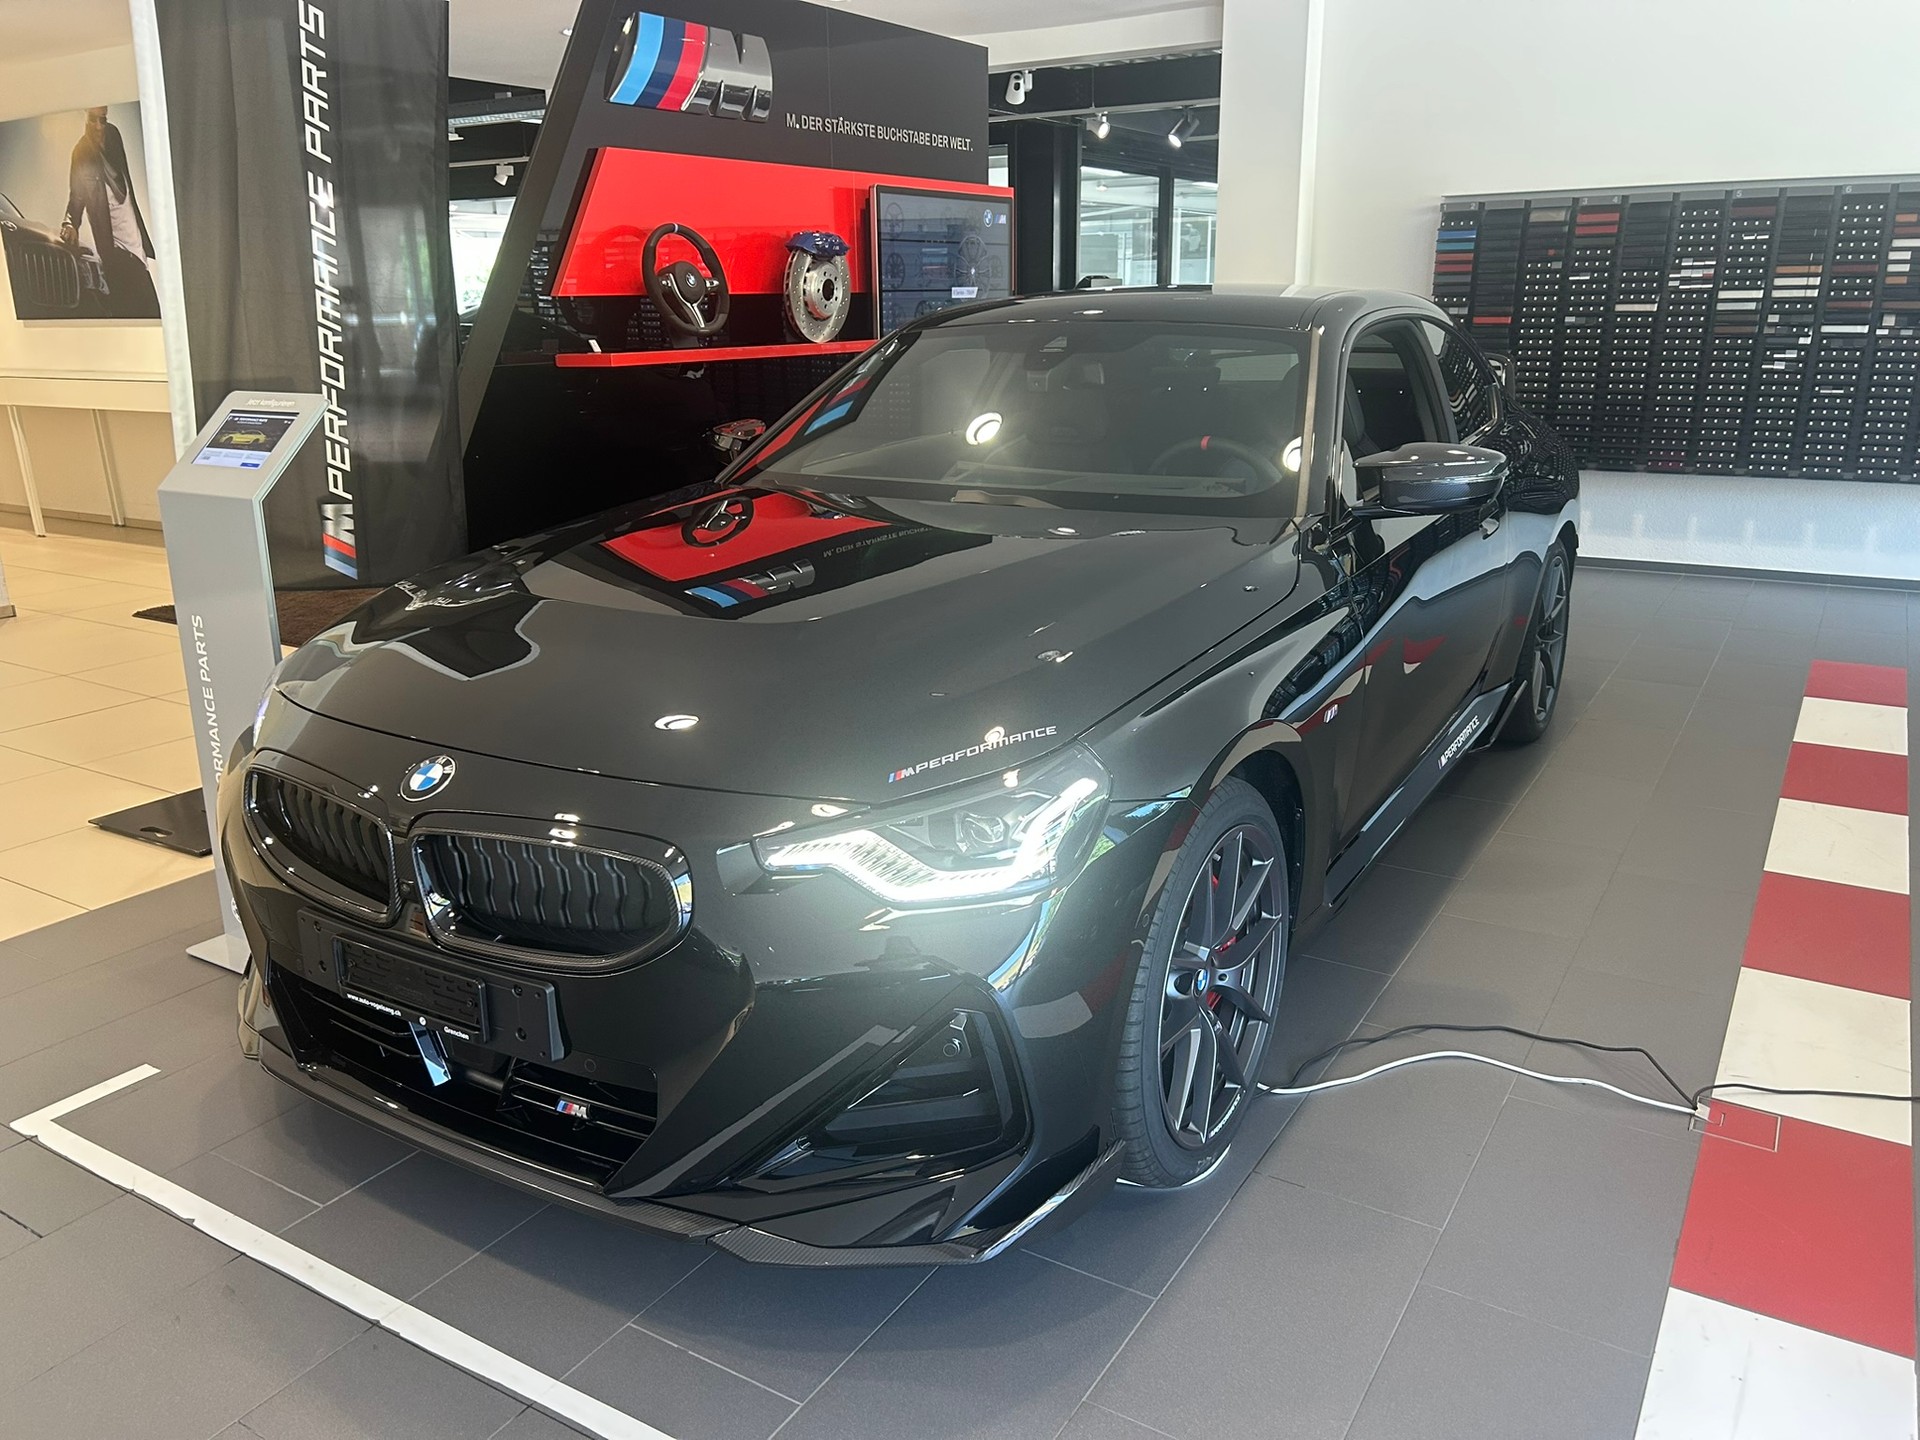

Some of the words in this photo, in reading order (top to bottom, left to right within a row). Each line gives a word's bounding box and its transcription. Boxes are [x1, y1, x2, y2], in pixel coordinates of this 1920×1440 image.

[298, 0, 332, 164] PARTS
[801, 114, 823, 132] DER
[824, 116, 876, 139] STÄRKSTE
[877, 127, 931, 146] BUCHSTABE
[931, 133, 949, 149] DER
[949, 137, 974, 152] WELT.
[307, 171, 353, 500] PERFORMANCE
[191, 614, 212, 682] PARTS
[916, 725, 1057, 774] PERFORMANCE
[1444, 715, 1480, 760] PERFORMANCE
